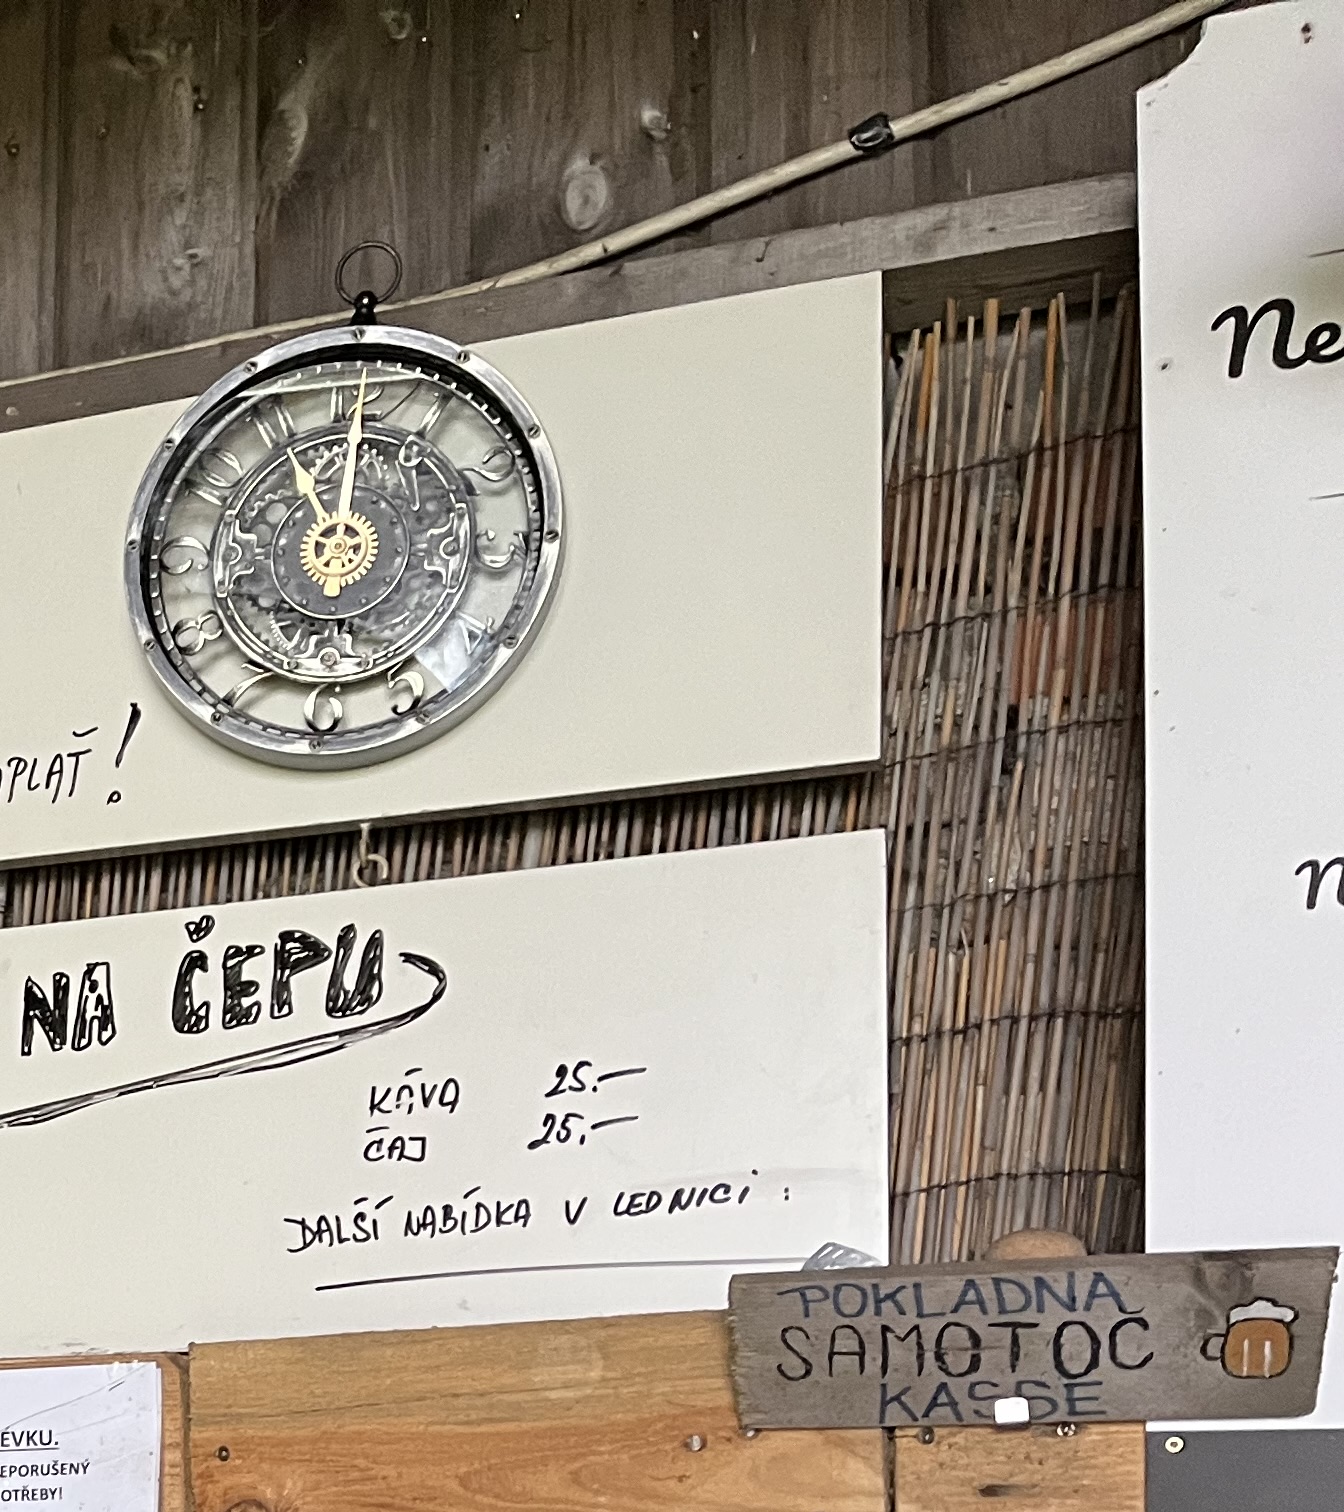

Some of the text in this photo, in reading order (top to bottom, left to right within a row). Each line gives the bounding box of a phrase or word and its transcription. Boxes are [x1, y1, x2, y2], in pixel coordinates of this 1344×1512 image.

[22, 915, 385, 1056] NA ČEPU
[565, 1200, 588, 1227] V
[777, 1271, 1128, 1320] POKLADNA
